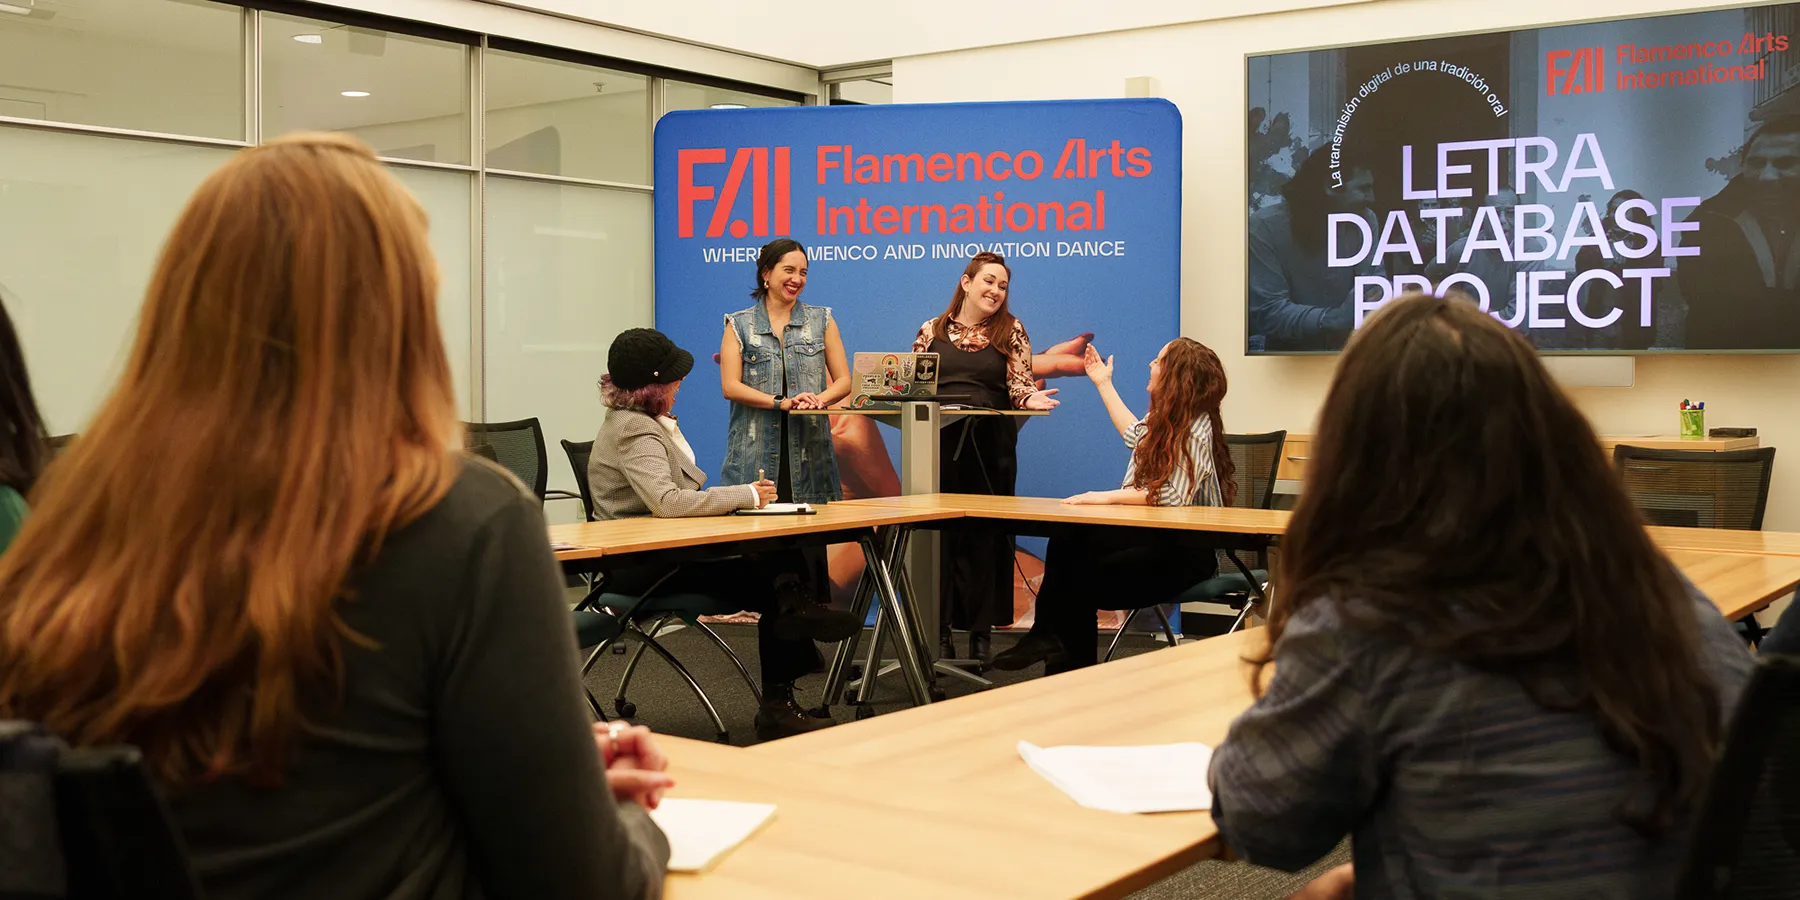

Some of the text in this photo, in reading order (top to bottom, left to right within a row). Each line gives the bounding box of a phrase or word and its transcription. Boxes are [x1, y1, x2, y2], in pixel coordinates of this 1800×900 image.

[1616, 31, 1789, 65] Flamenco Arts
[1616, 57, 1765, 91] International
[1328, 60, 1508, 189] La transmisión digital de una tradición oral
[816, 138, 1153, 184] Flamenco Arts
[1402, 132, 1615, 201] LETRA
[816, 190, 1105, 236] International
[1327, 195, 1701, 268] DATABASE
[884, 244, 925, 260] AND
[931, 242, 1050, 259] INNOVATION
[1056, 241, 1125, 257] DANCE
